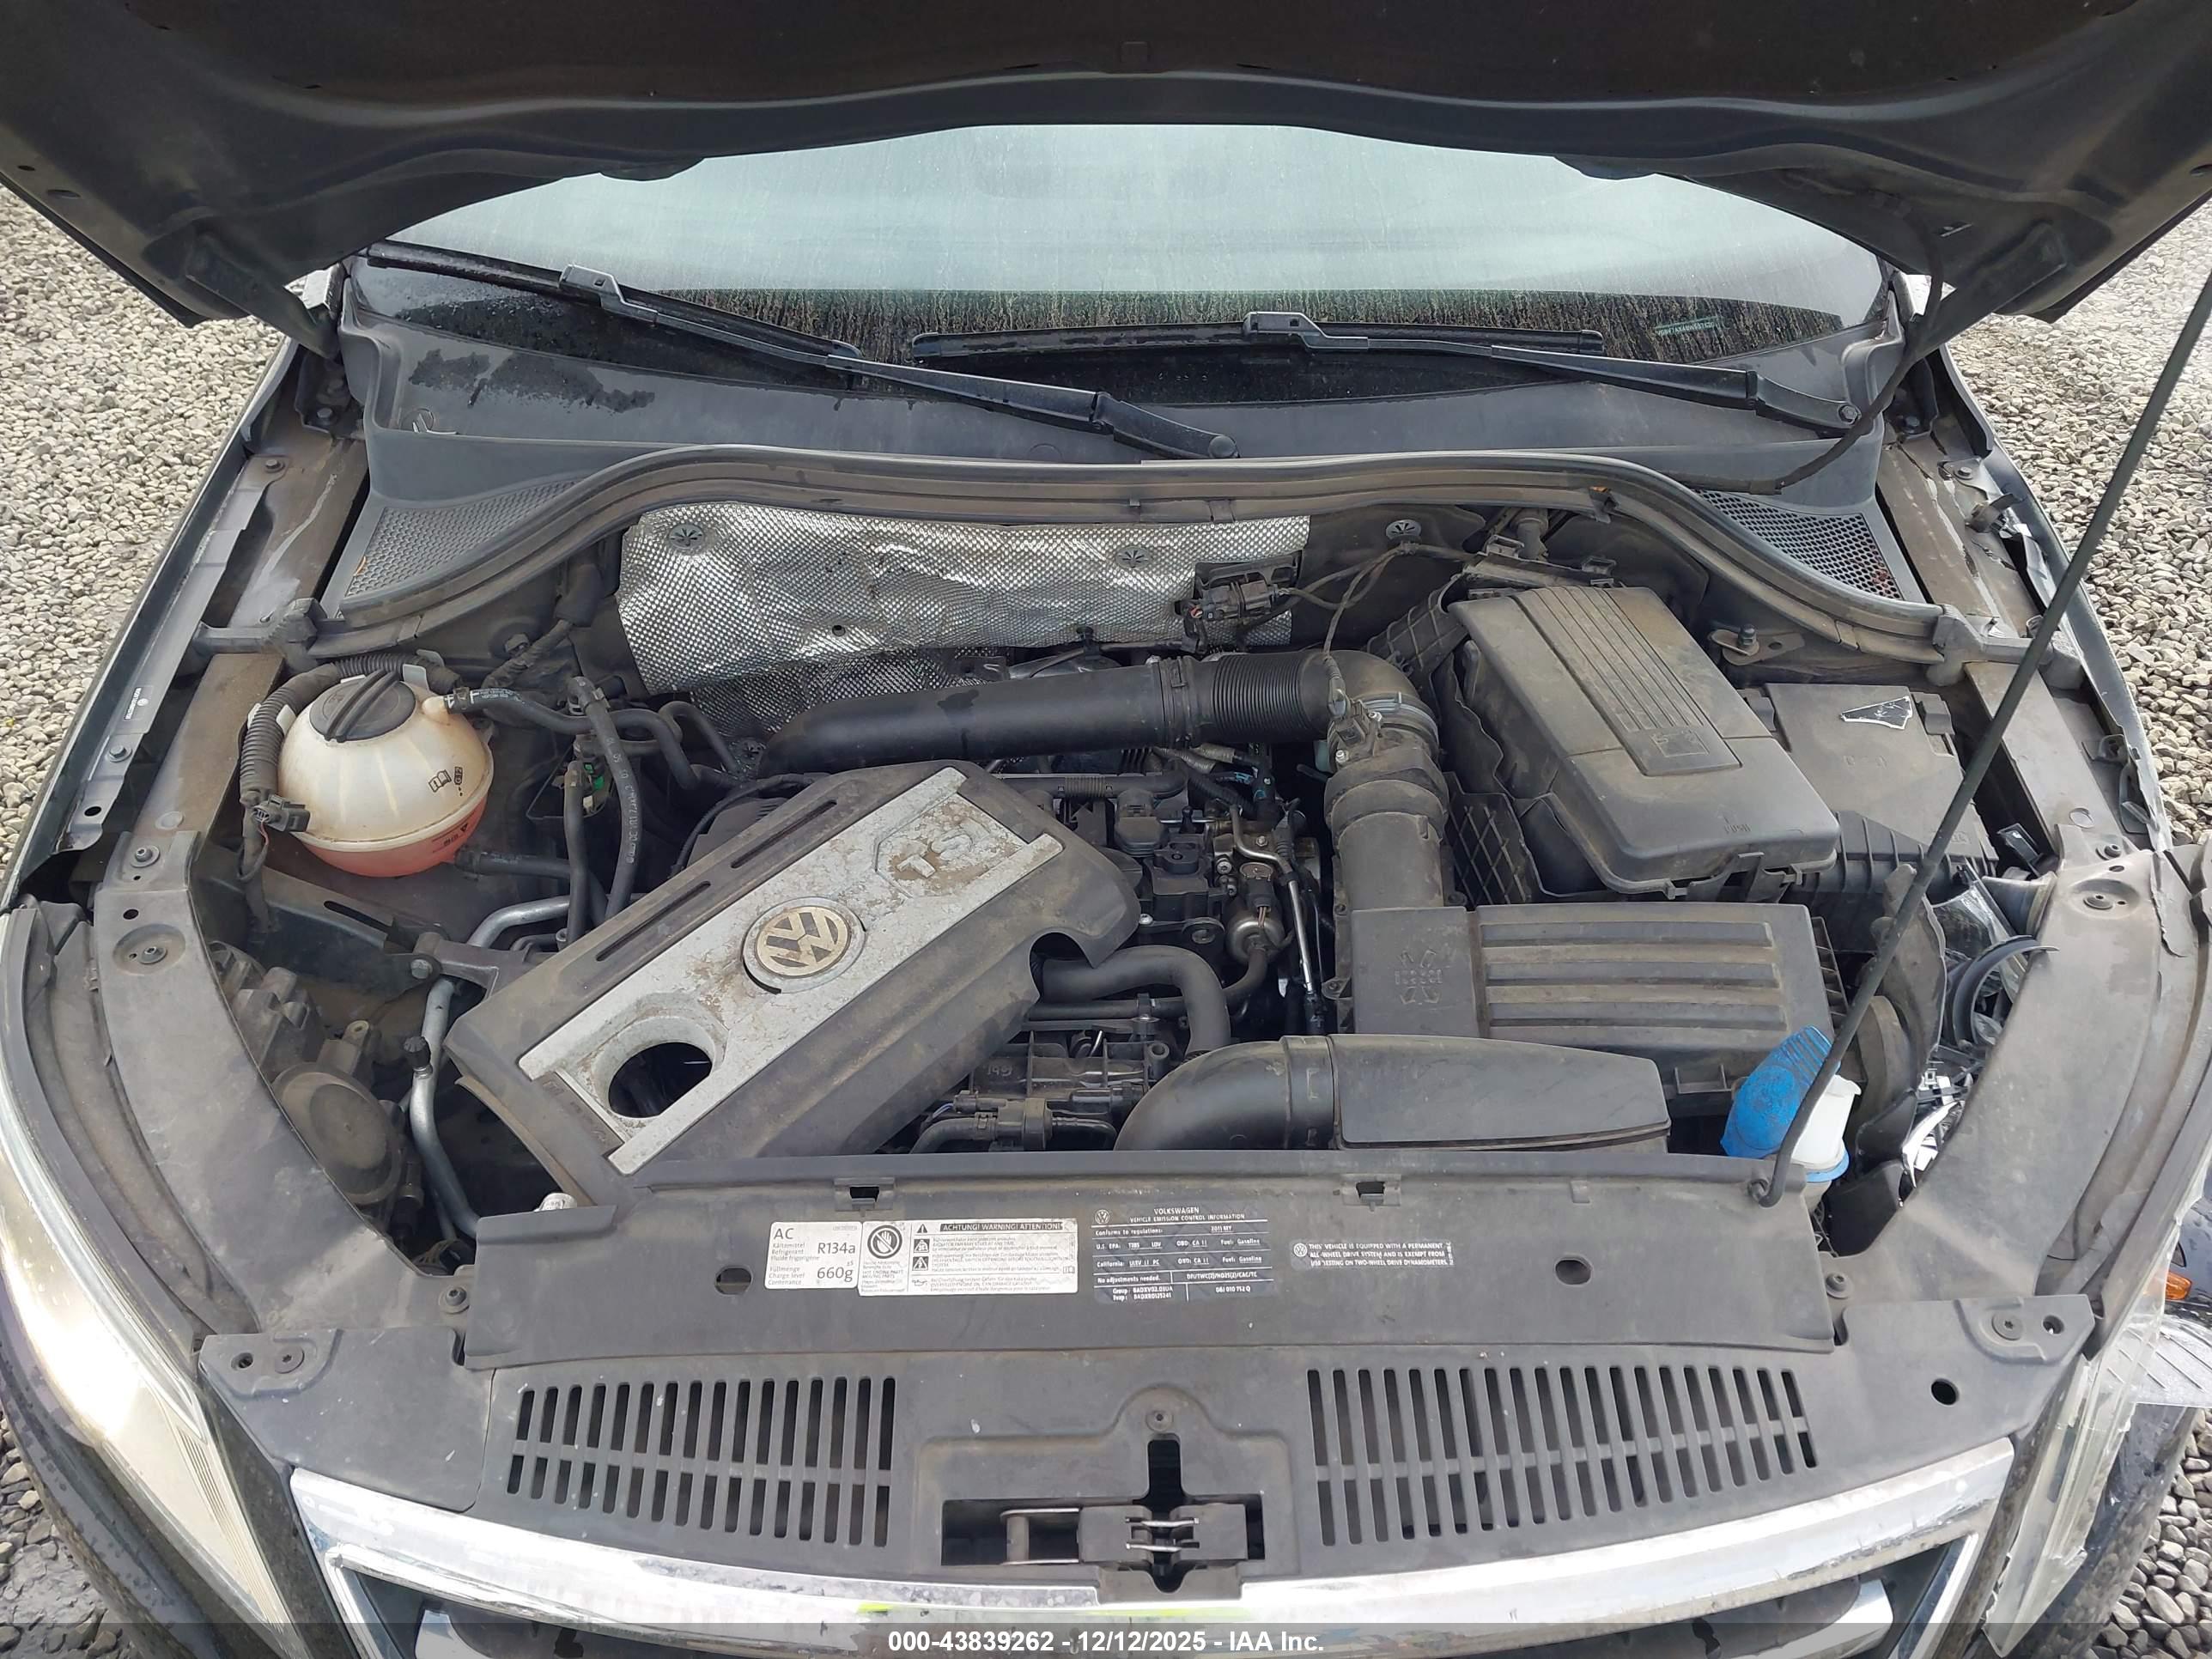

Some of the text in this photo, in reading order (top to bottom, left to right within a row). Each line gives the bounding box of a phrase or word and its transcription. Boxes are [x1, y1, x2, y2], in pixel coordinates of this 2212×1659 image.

[774, 1228, 794, 1240] AC
[817, 1242, 856, 1255] R134a
[817, 1267, 854, 1282] 660g
[1106, 1275, 1139, 1284] adjustments
